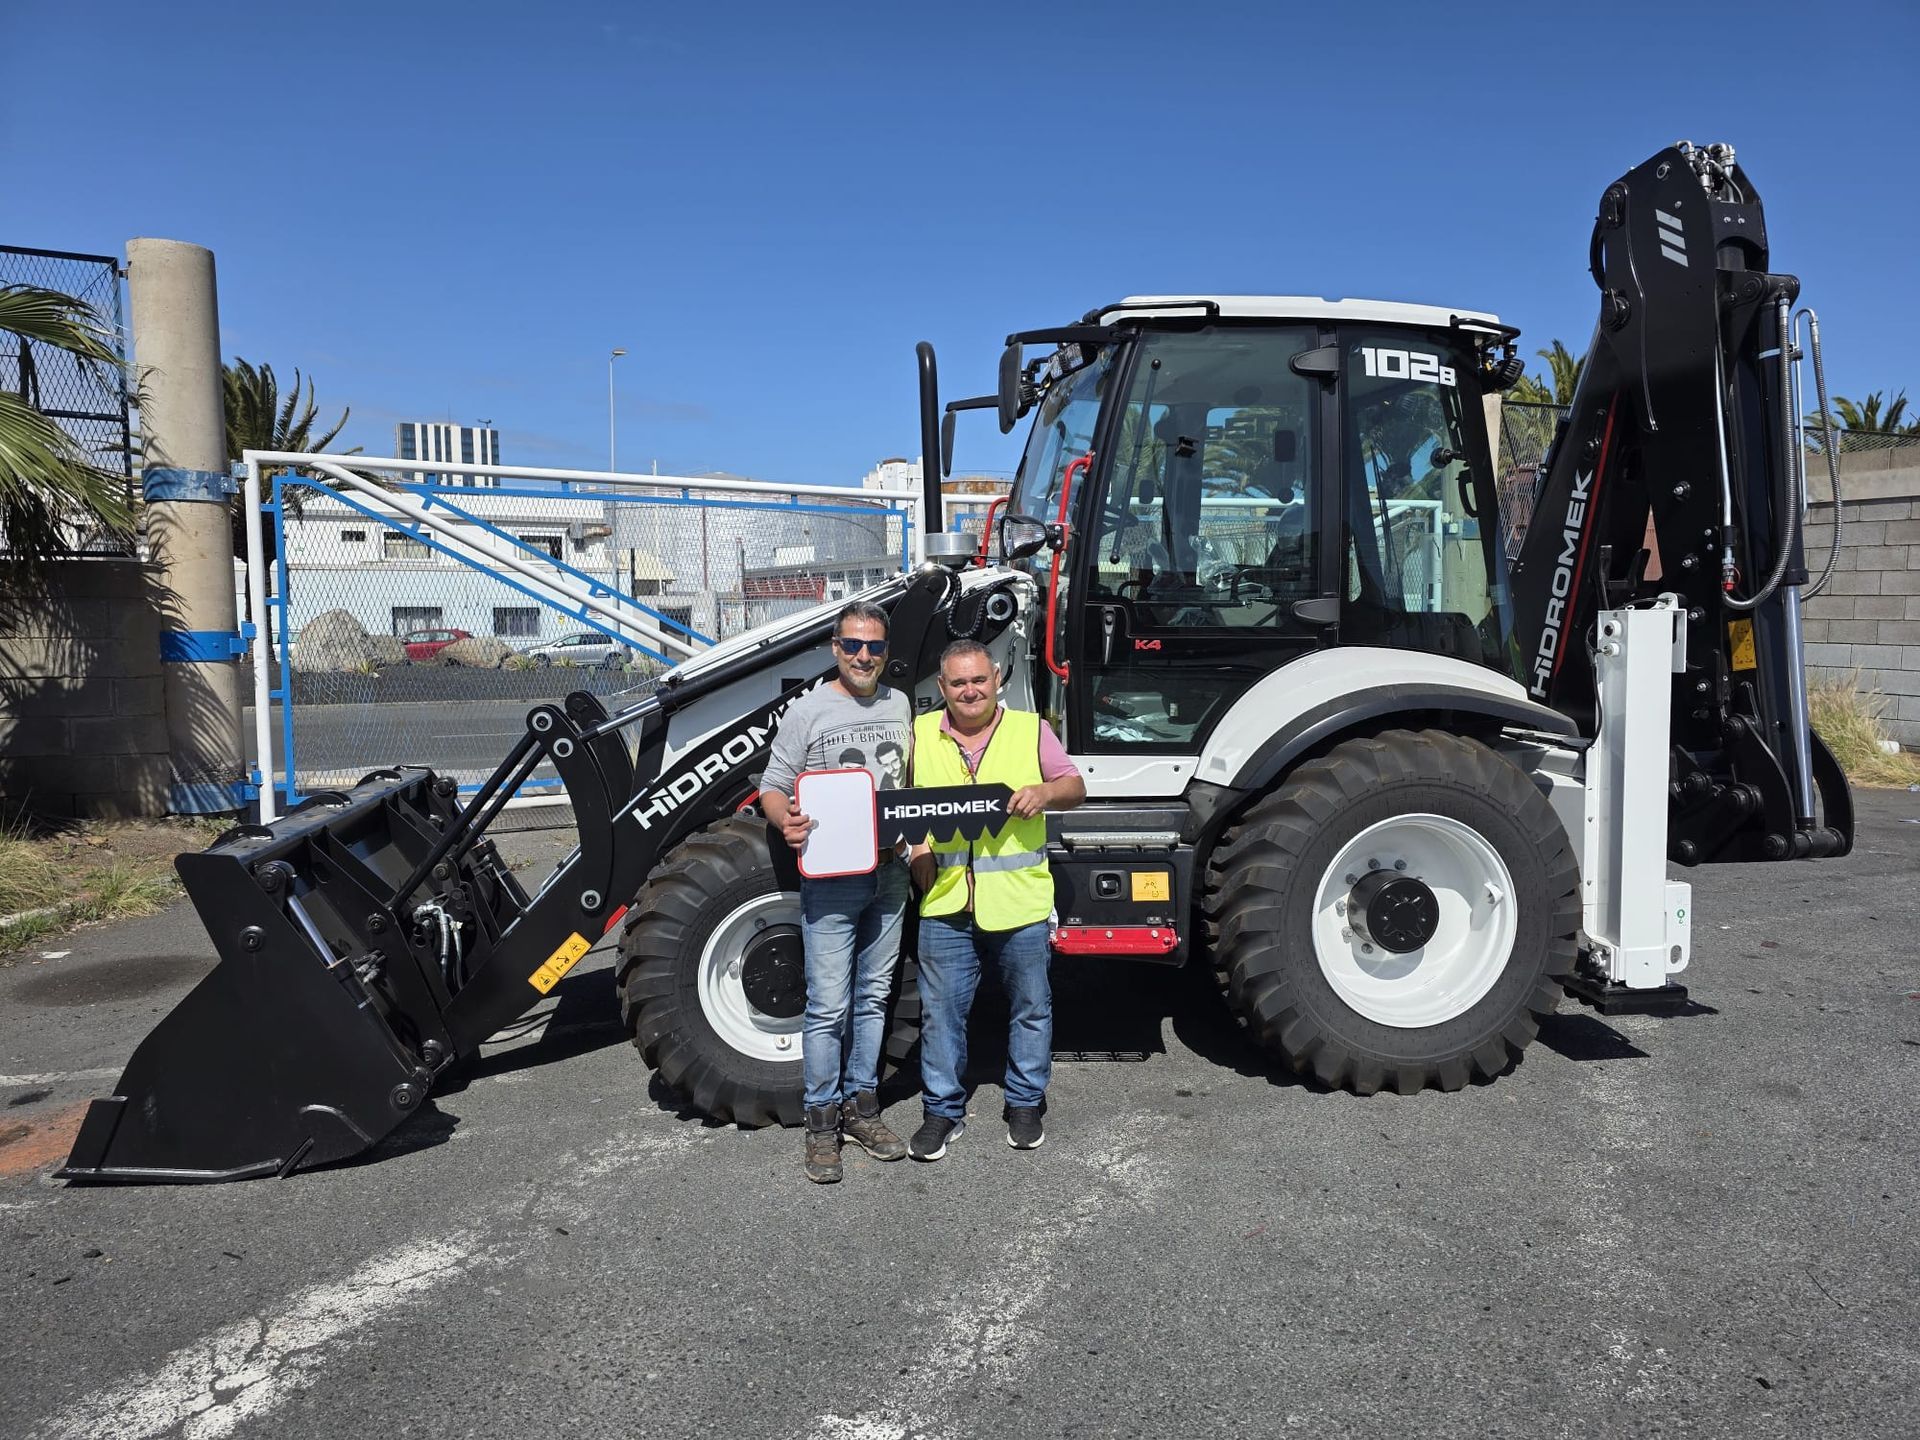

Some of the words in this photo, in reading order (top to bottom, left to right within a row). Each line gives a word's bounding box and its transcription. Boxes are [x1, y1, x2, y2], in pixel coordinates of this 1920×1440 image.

[1361, 347, 1456, 387] 102B
[1135, 639, 1162, 651] K4
[860, 730, 907, 743] BANDITS
